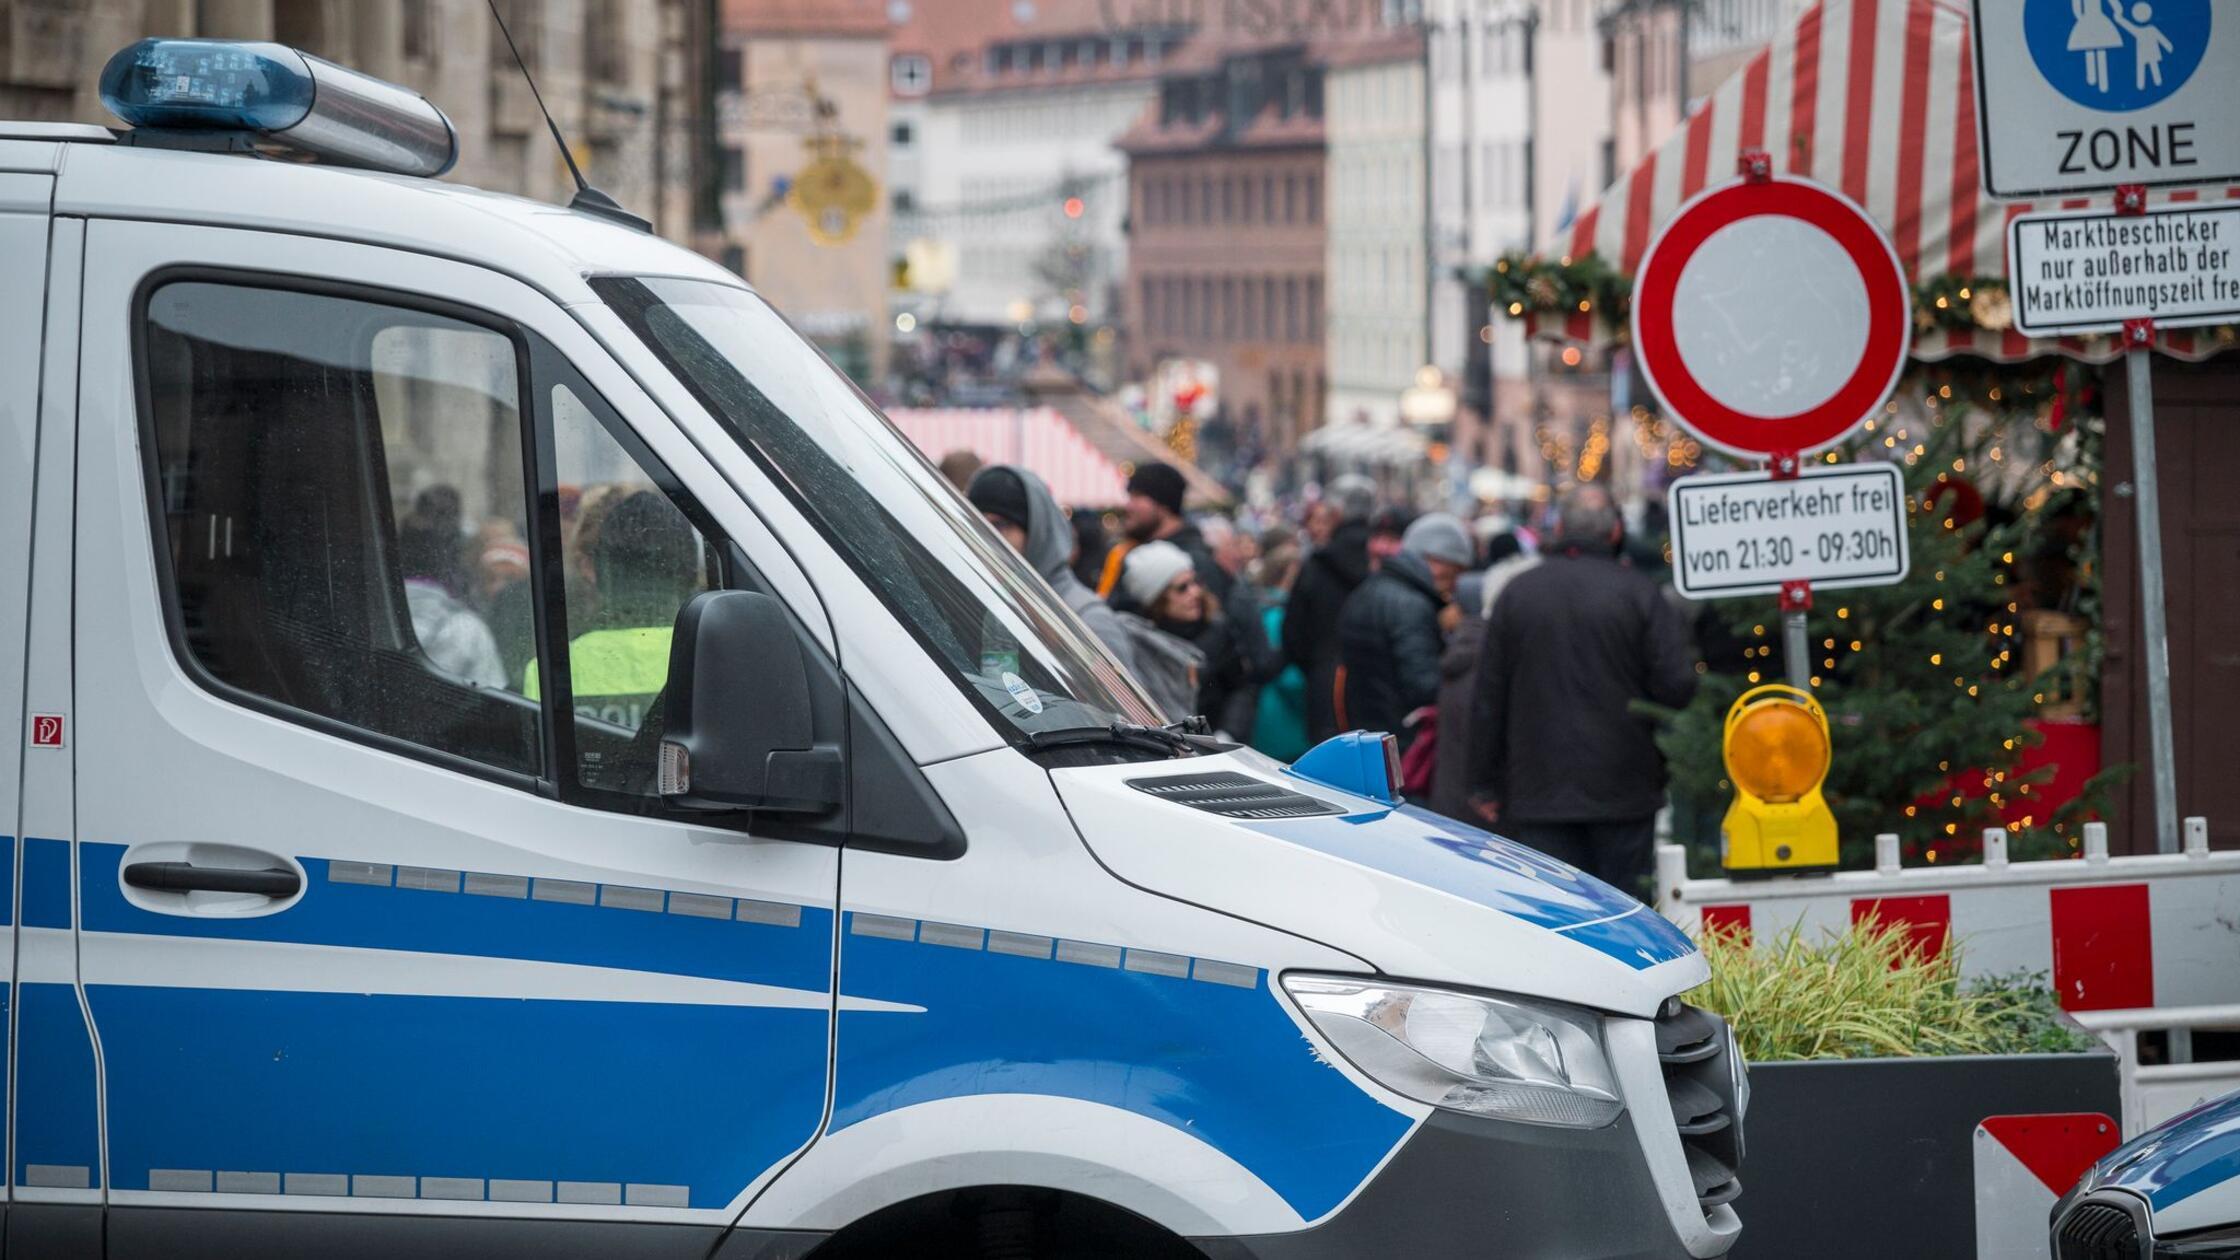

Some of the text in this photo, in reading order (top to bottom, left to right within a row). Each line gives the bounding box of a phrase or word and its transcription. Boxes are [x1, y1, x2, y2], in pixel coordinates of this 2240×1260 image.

[2057, 123, 2197, 174] ZONE
[2044, 214, 2220, 250] Marktbeschicker
[2041, 244, 2230, 280] nur außerhalb der
[2027, 275, 2204, 311] Marktöffnungszeit
[1685, 480, 1890, 526] Lieferverkehr frei
[1688, 549, 1730, 573] von
[1736, 536, 1793, 570] 21:30
[1818, 529, 1893, 563] 09:30h
